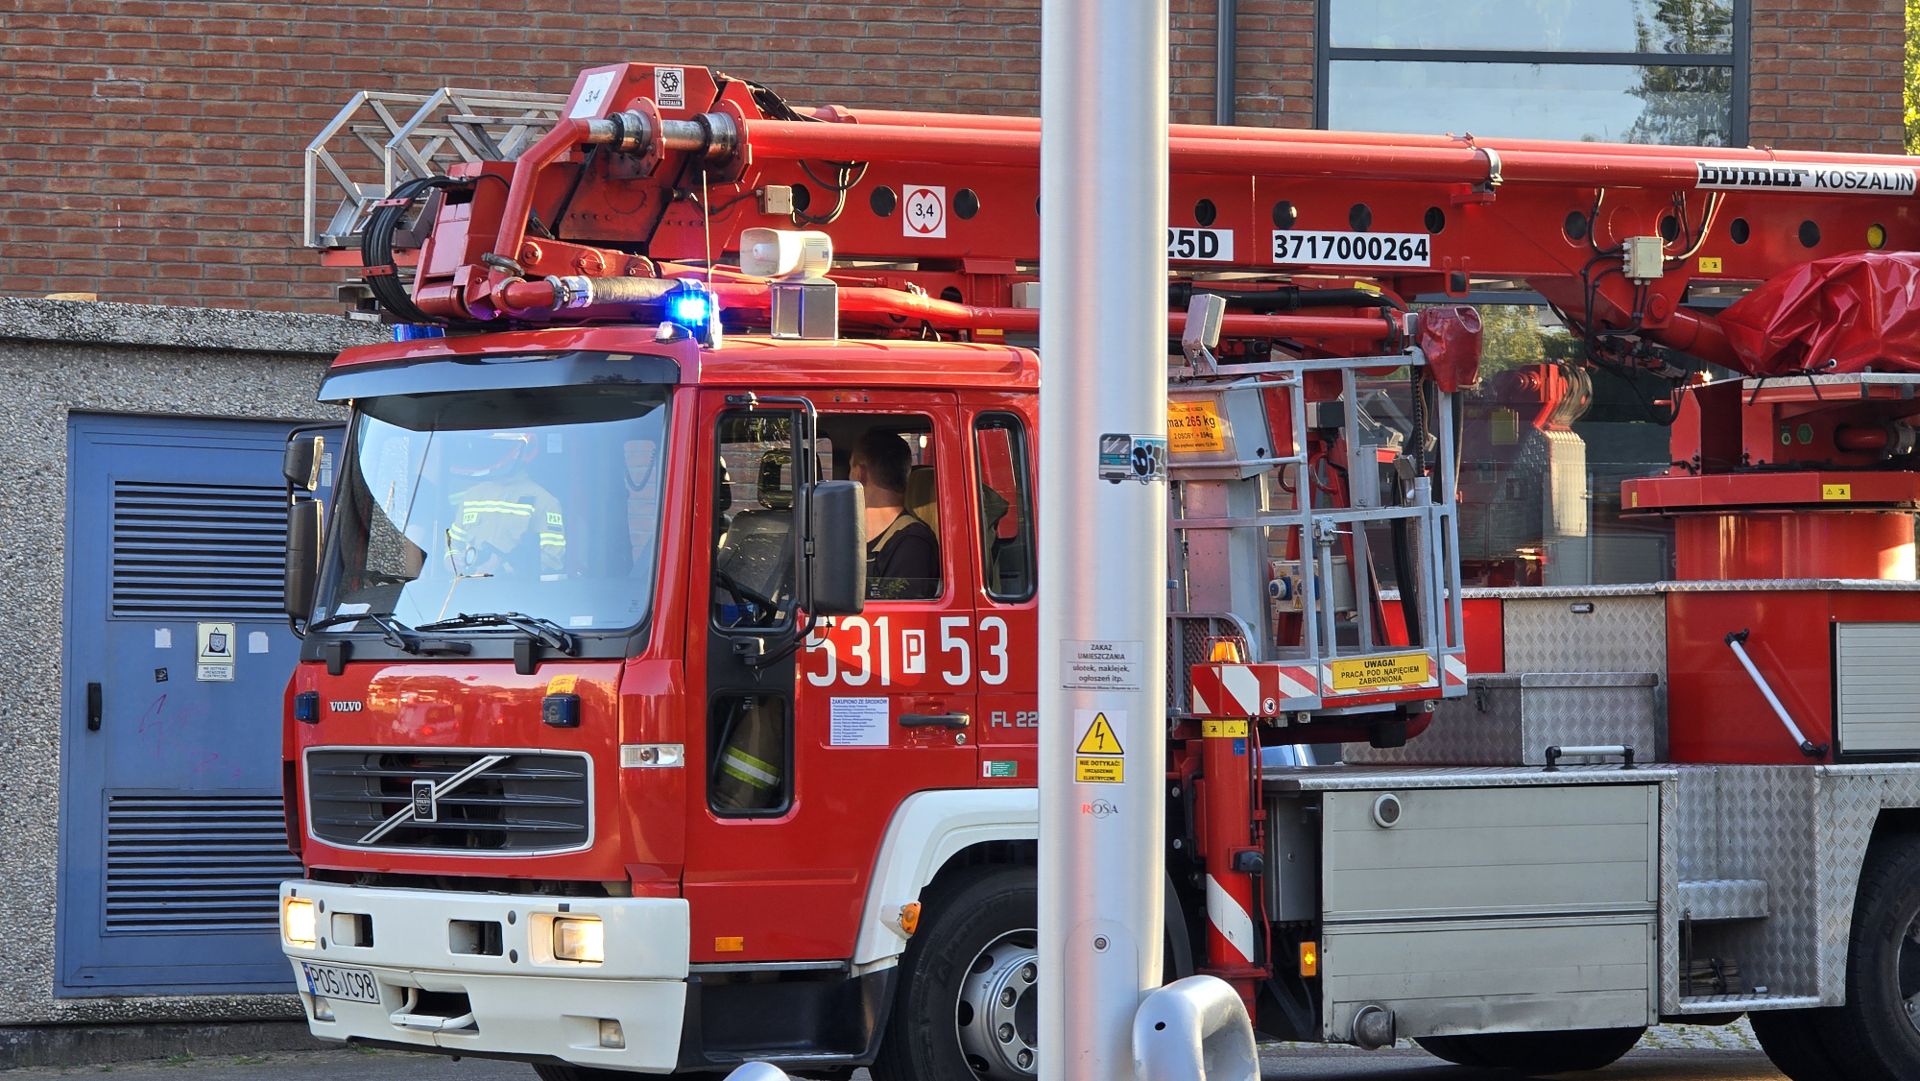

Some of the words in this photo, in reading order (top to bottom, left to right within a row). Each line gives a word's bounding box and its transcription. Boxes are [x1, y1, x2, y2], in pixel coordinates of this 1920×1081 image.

[1698, 162, 1809, 186] bumar
[1815, 170, 1914, 190] KOSZALIN
[916, 202, 934, 219] 3,4
[1274, 234, 1429, 261] 3717000264
[1186, 416, 1202, 426] 265
[1203, 416, 1216, 428] kg
[804, 616, 890, 686] 531
[906, 634, 922, 670] P
[940, 616, 1008, 686] 53
[1098, 664, 1130, 673] naklejek,
[1364, 659, 1396, 668] UWAGA!
[1079, 674, 1110, 682] ogłoszeń
[1341, 670, 1364, 678] PRACA
[1384, 666, 1420, 675] NAPIĘCIEM
[1359, 676, 1402, 684] ZABRONIONA
[330, 701, 362, 712] VOLVO
[992, 711, 1012, 728] FL
[1082, 803, 1118, 814] ROSA
[310, 966, 340, 994] POS
[341, 971, 375, 998] JC98
